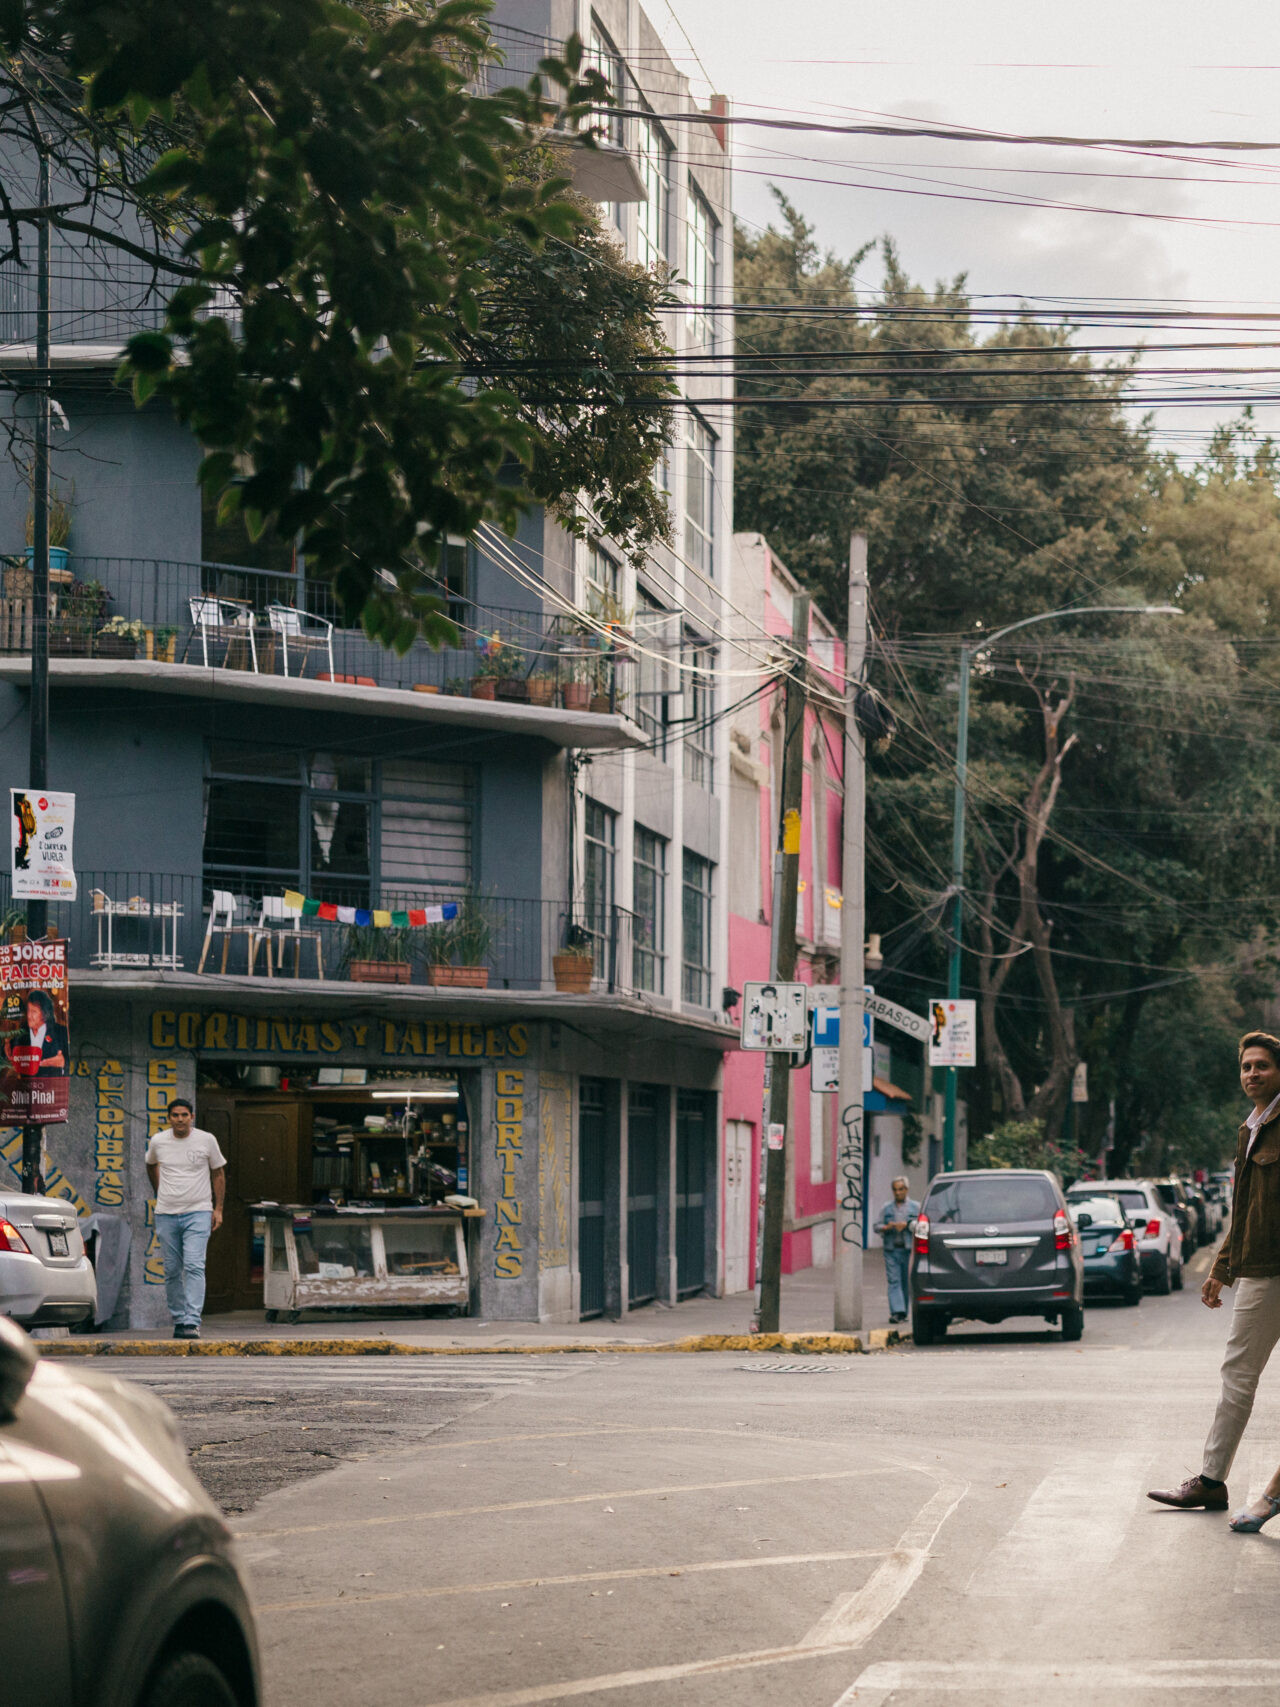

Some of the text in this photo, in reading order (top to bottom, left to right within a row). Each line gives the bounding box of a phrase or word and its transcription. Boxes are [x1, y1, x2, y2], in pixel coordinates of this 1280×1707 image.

[12, 945, 65, 962] JORGE
[1, 960, 65, 982] FALCÓN
[2, 982, 12, 991] LA
[863, 997, 920, 1032] TABASCO
[150, 1009, 529, 1058] CORTINAS Y TAPICES
[31, 1090, 55, 1105] Pinal
[494, 1069, 524, 1279] CORTINAS
